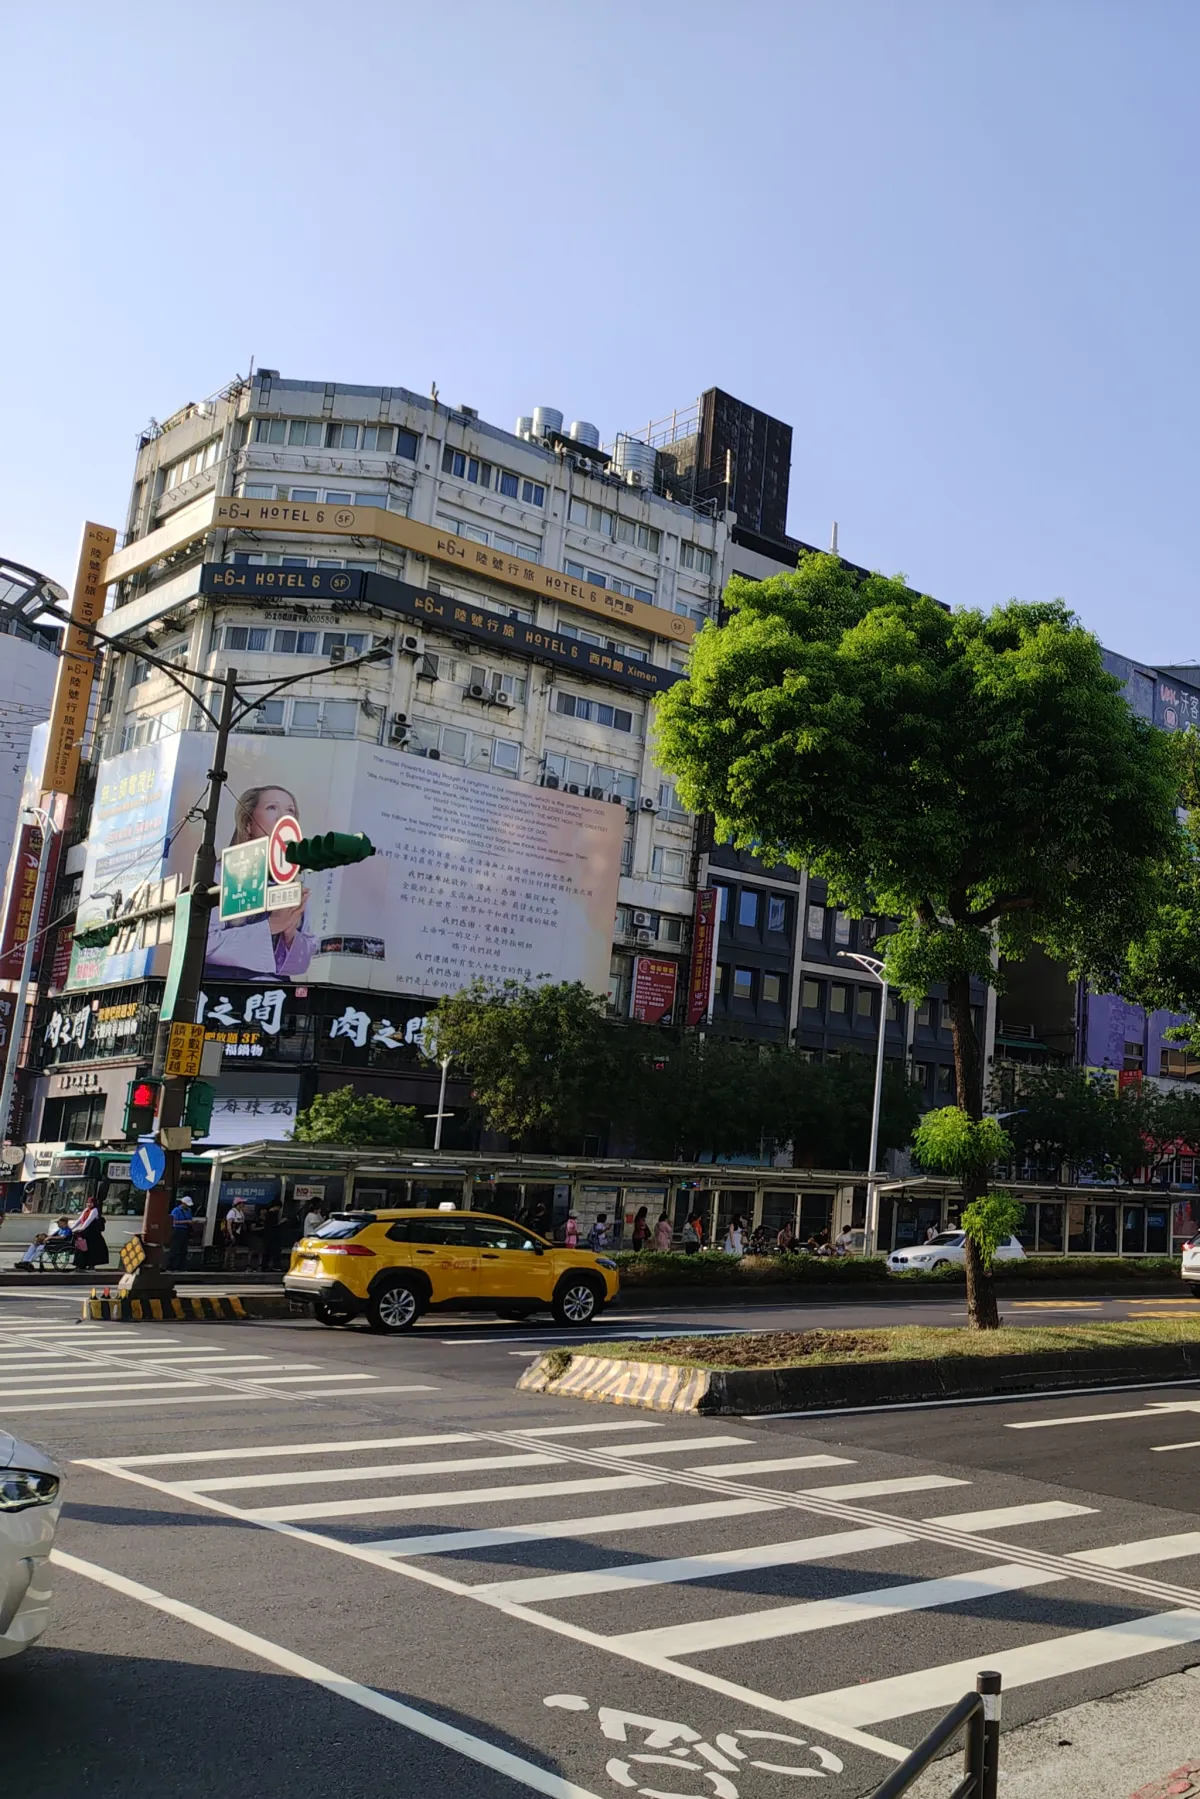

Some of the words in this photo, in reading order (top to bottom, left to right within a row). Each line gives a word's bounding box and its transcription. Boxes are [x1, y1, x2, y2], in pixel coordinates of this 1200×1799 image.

[260, 506, 310, 522] HOTEL
[316, 510, 324, 522] 6
[338, 515, 350, 523] 5F
[84, 548, 101, 596] 陸號行旅
[256, 573, 305, 587] HOTEL
[312, 576, 320, 588] 6
[333, 579, 346, 587] 5F
[476, 551, 535, 582] 陸號行旅
[546, 575, 585, 599] HOTEL
[590, 592, 597, 603] 6
[604, 595, 634, 614] 西門館
[454, 607, 515, 639] 陸號行旅
[526, 632, 566, 655] HOTEL
[571, 647, 578, 658] 6
[589, 652, 623, 674] 西門館
[627, 665, 658, 684] Ximen
[63, 676, 80, 725] 陸號行旅
[44, 1004, 90, 1049] 肉之間
[168, 1023, 186, 1073] 請勿穿越
[185, 1026, 204, 1074] 秒數不足
[242, 1033, 260, 1044] 3F
[329, 1006, 438, 1059] 肉之間
